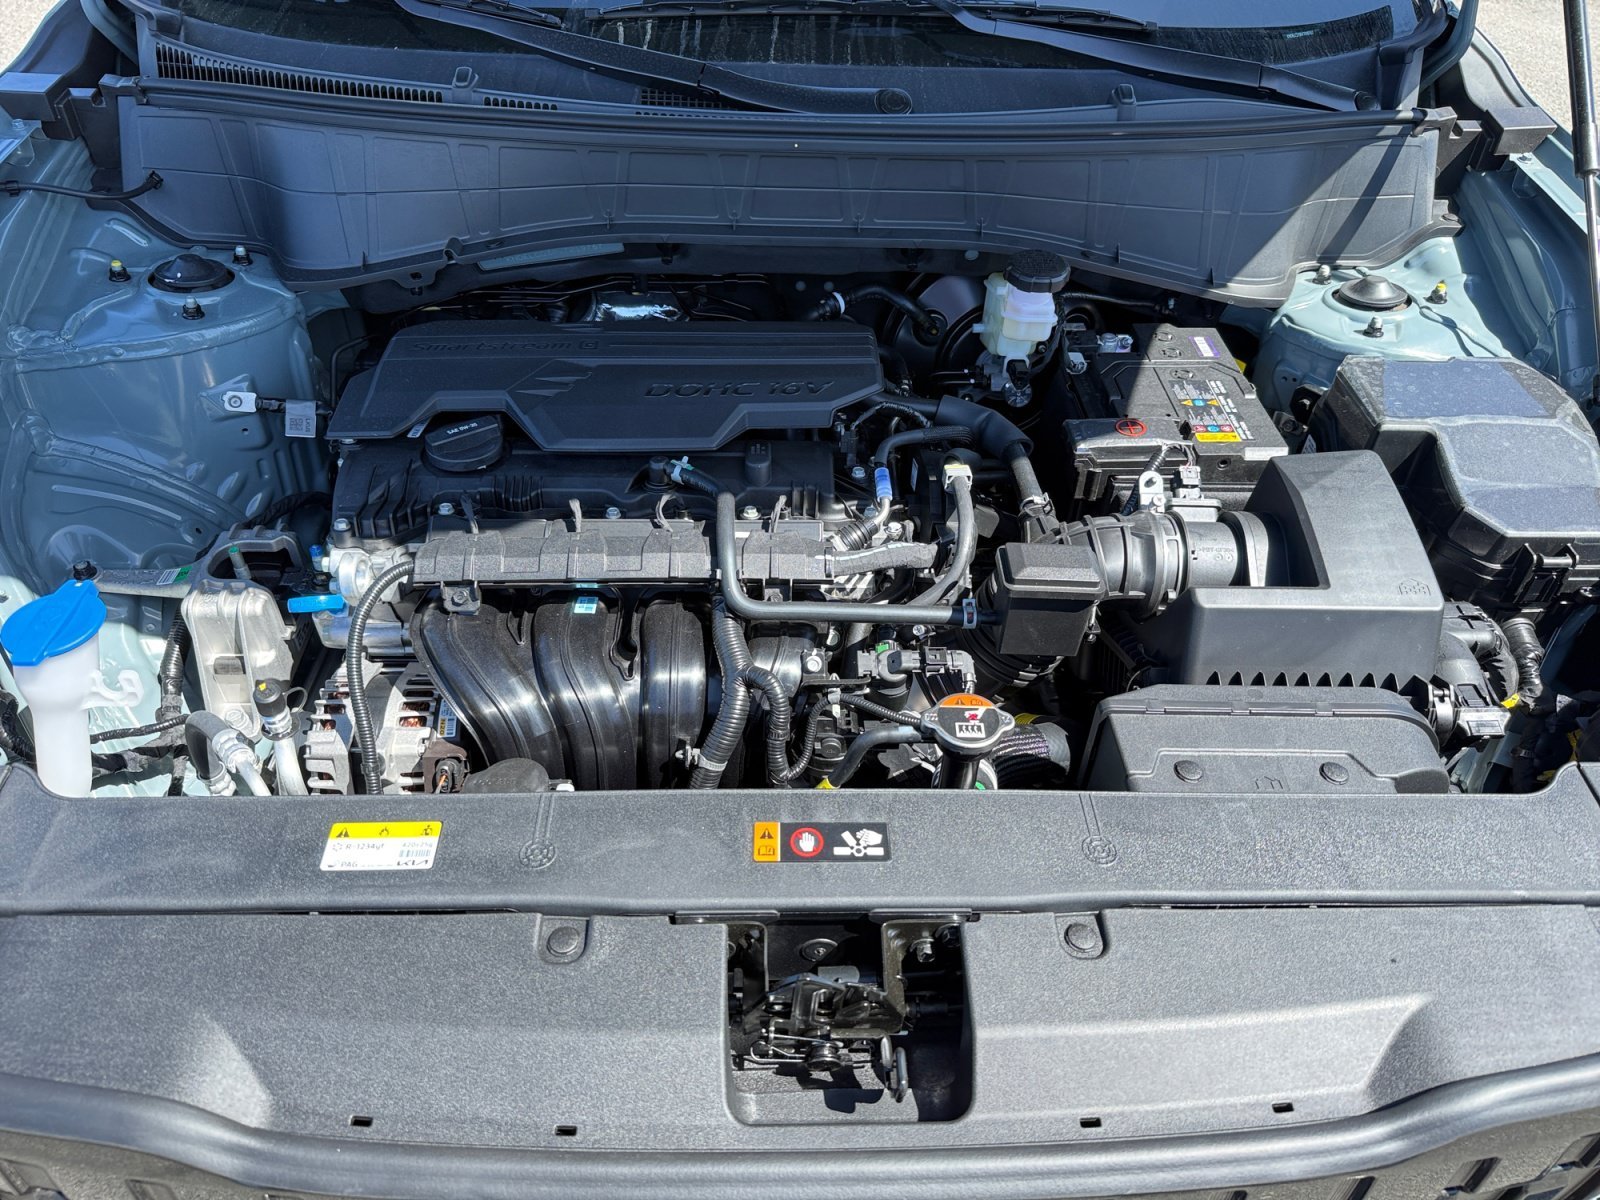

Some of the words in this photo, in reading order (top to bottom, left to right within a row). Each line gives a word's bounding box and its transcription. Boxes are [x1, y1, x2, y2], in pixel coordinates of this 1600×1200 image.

[413, 341, 572, 351] Smartstream
[644, 382, 761, 398] DOHC
[768, 381, 835, 396] 16V
